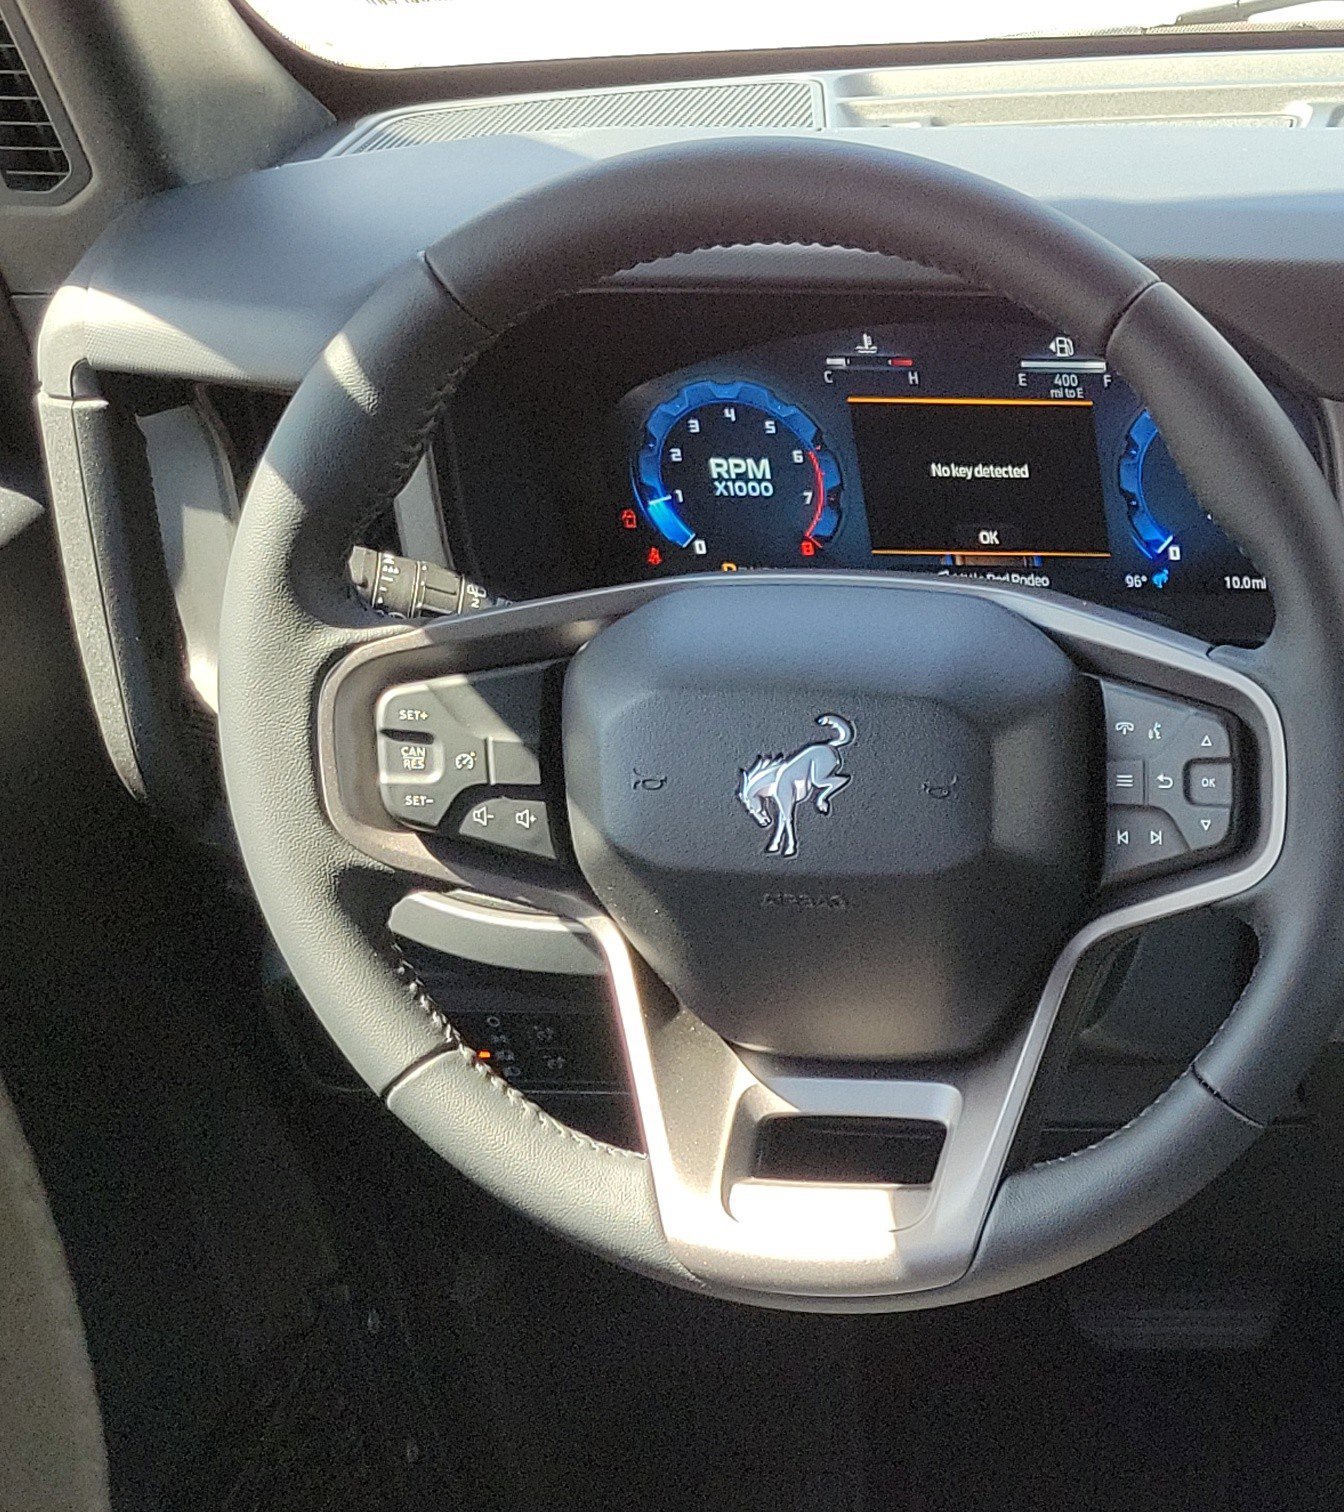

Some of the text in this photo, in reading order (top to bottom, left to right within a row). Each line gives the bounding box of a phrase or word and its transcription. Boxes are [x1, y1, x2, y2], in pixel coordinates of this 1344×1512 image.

[823, 370, 834, 384] C
[908, 371, 919, 385] H
[1018, 373, 1028, 387] E
[1054, 373, 1079, 387] 400
[1103, 374, 1112, 388] F
[723, 406, 736, 422] 4
[687, 418, 701, 433] 3
[764, 420, 776, 434] 5
[669, 448, 683, 462] 2
[792, 450, 804, 464] 6
[708, 457, 772, 480] RPM
[931, 462, 1030, 480] No key detected
[714, 480, 774, 497] X1000
[675, 489, 684, 503] 1
[803, 491, 813, 505] 7
[979, 529, 1000, 545] OK
[694, 538, 707, 555] 0
[401, 747, 426, 757] CAN
[403, 759, 426, 771] RES
[1201, 778, 1216, 789] OK
